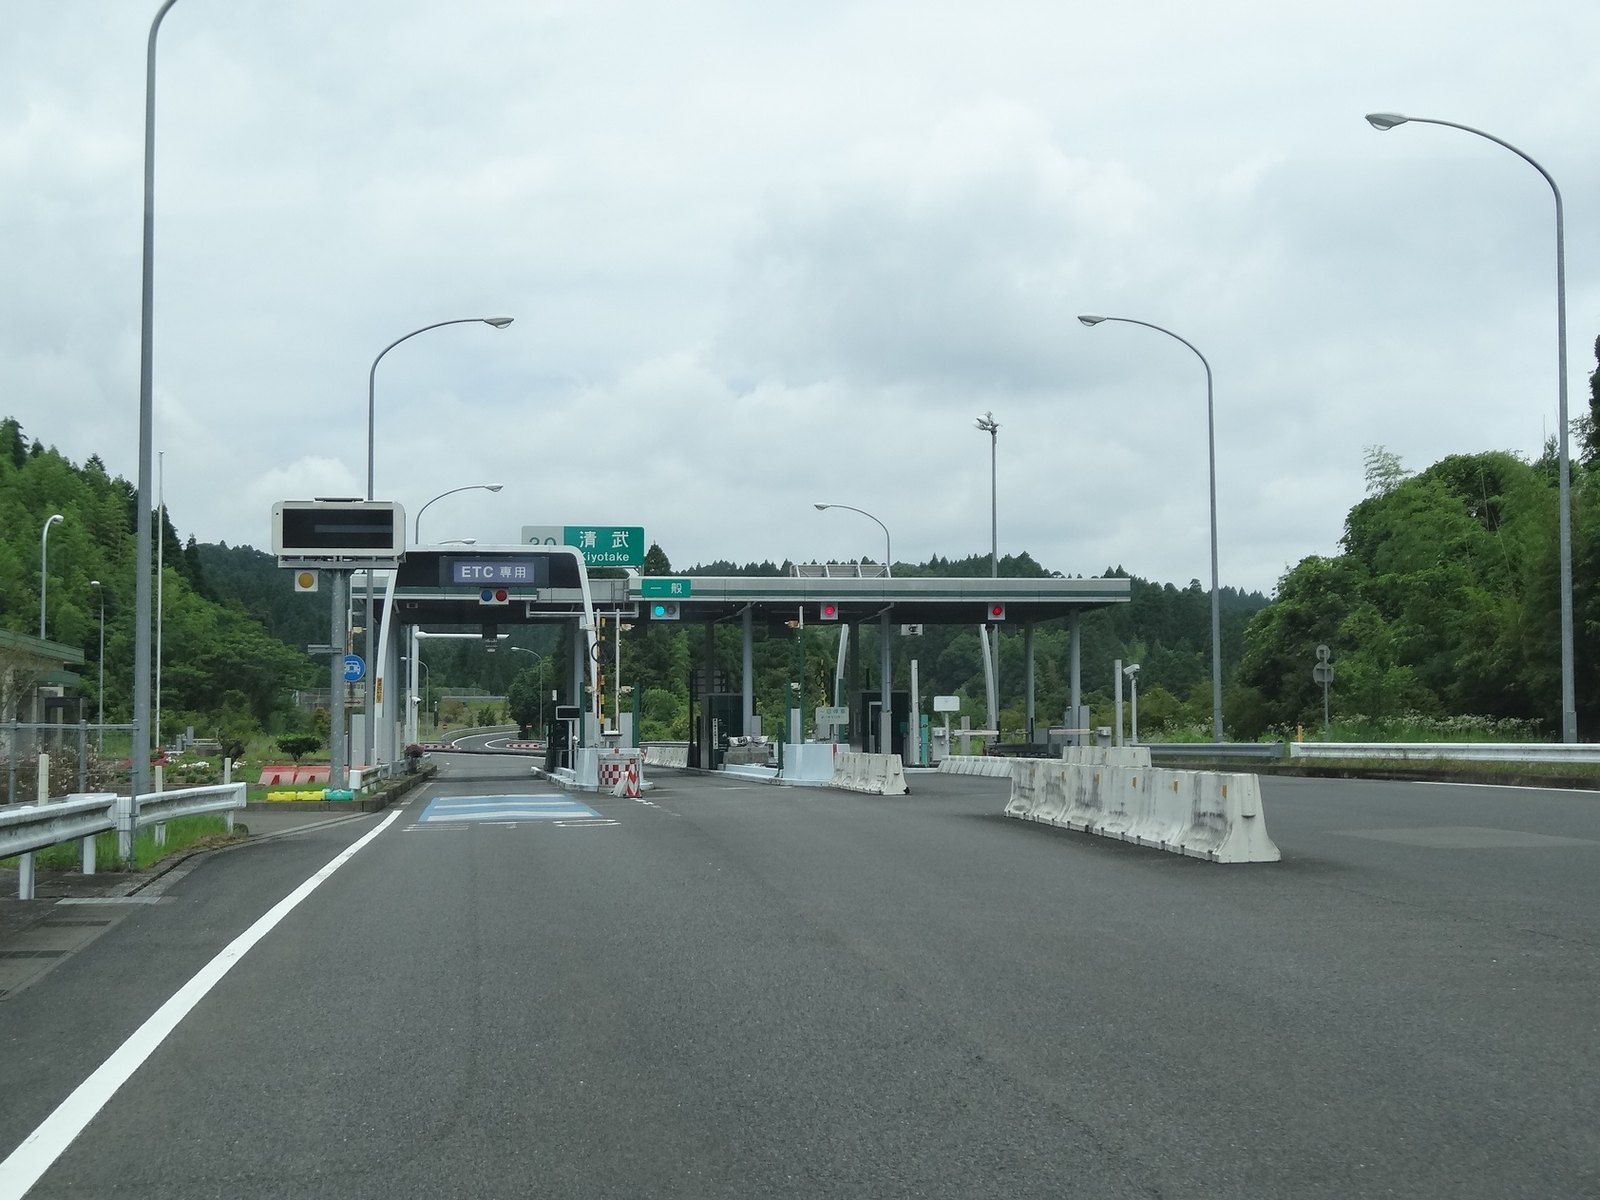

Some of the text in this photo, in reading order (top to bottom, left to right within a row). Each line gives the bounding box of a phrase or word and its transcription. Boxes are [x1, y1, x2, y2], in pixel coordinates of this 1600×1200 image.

[579, 530, 629, 549] 清武
[461, 566, 526, 578] ETC 専用
[650, 583, 683, 594] 一般
